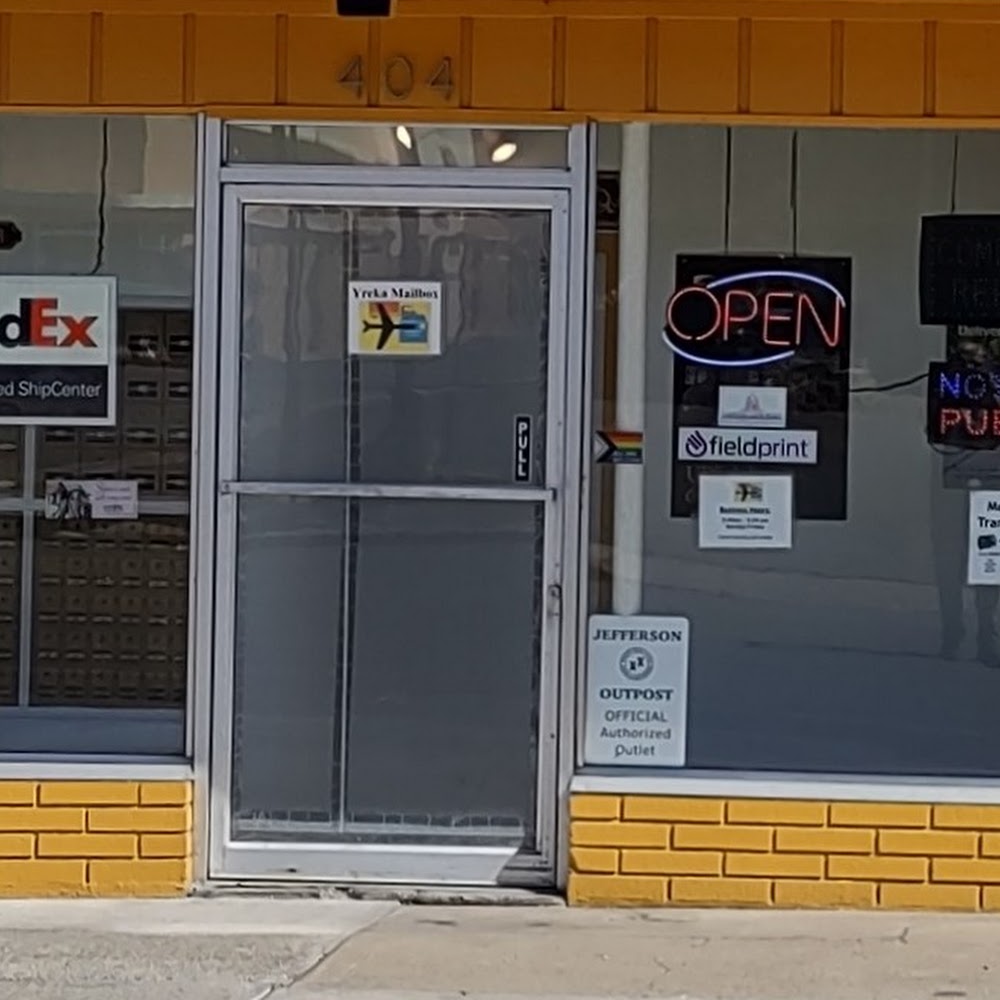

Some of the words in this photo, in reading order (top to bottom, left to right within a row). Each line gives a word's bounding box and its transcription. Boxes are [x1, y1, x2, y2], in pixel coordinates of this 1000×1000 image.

[336, 54, 455, 101] 404
[353, 287, 388, 299] Yreka
[392, 287, 438, 299] Mailbox
[667, 285, 842, 347] OPEN
[18, 380, 102, 399] ShipCenter
[518, 421, 528, 477] PULL
[708, 435, 809, 460] fieldprint
[592, 629, 683, 642] JEFFERSON
[599, 687, 674, 701] OUTPOST
[604, 709, 668, 723] OFFICIAL
[600, 726, 672, 740] Authorized
[614, 744, 656, 758] Outlet
